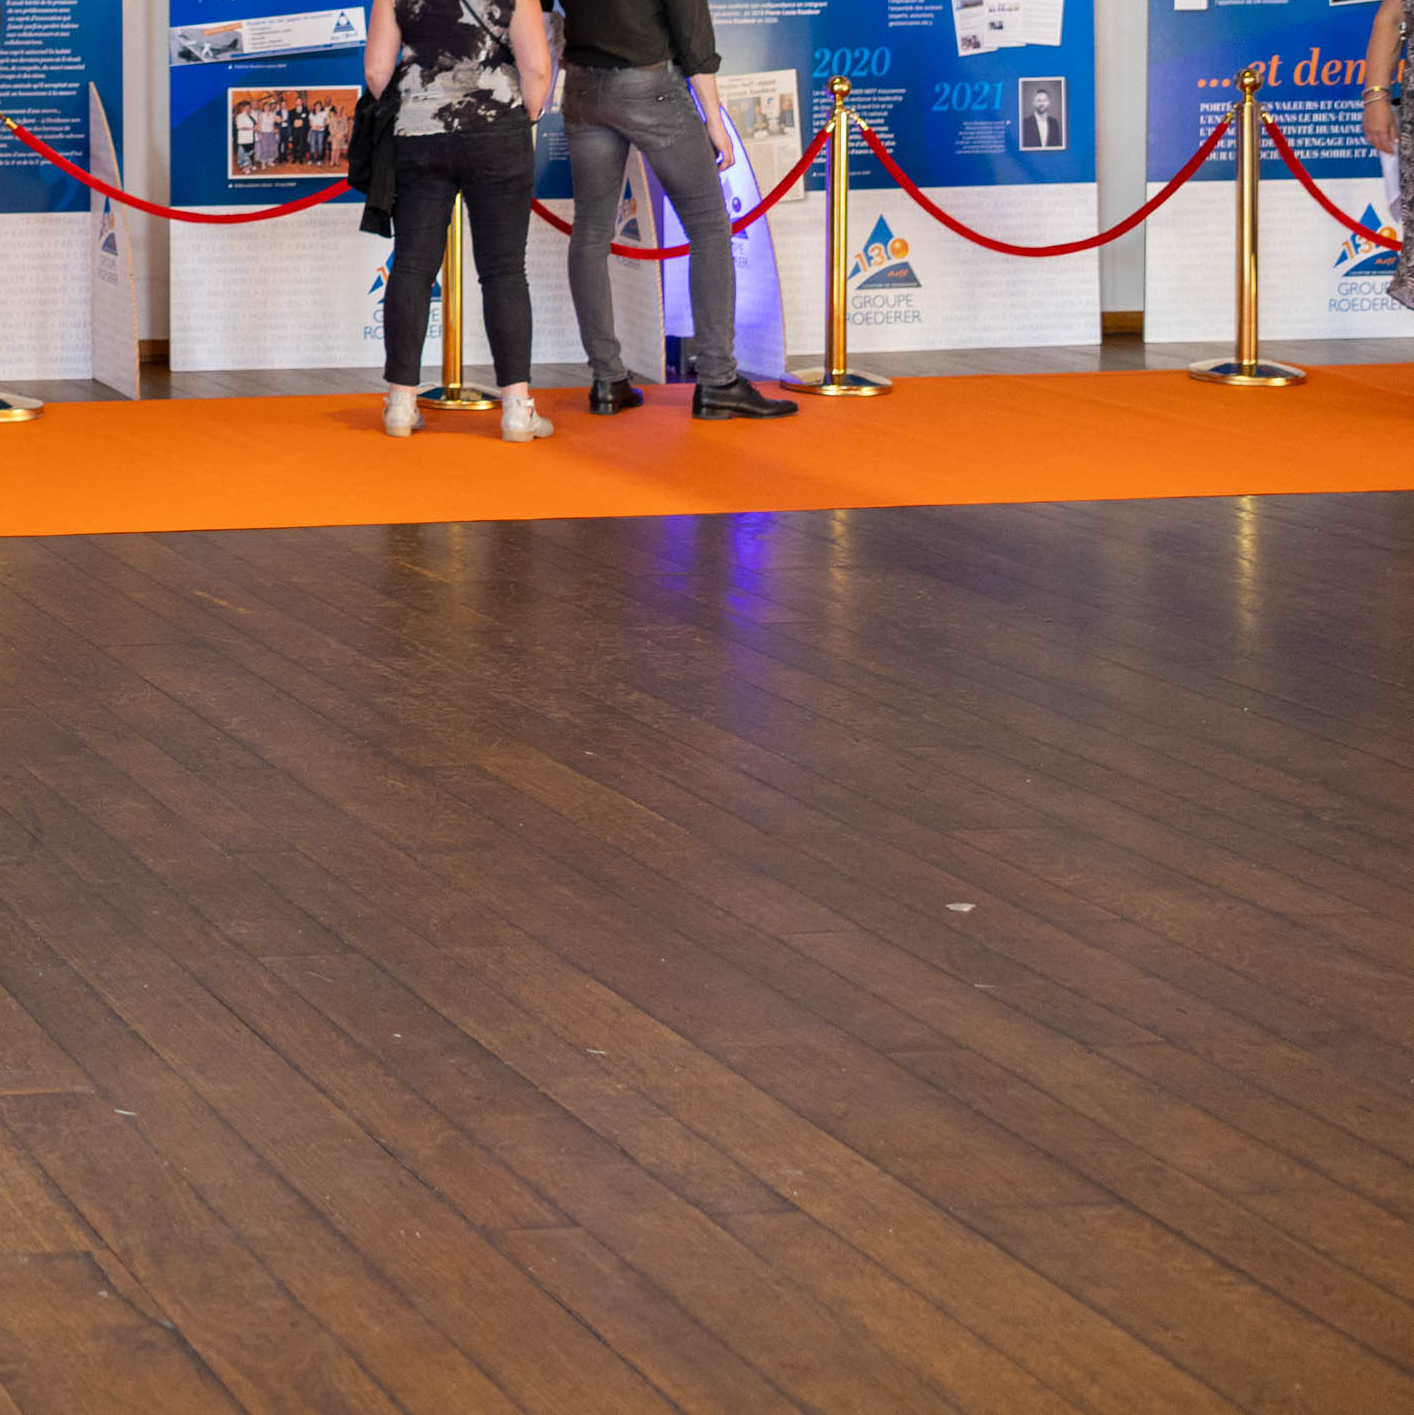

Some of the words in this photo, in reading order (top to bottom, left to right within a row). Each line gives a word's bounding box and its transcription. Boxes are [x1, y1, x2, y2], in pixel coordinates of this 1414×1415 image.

[812, 47, 892, 78] 2020
[932, 81, 1005, 112] 2021
[1200, 101, 1231, 111] PORTÉ
[1275, 101, 1319, 110] VALEURS
[1320, 101, 1332, 109] ET
[1273, 114, 1297, 123] DANS
[1299, 114, 1310, 122] LE
[1297, 137, 1343, 146] S'ENGAGE
[1295, 149, 1318, 158] PLUS
[1320, 149, 1352, 158] SOBRE
[1354, 149, 1366, 157] ET
[855, 238, 909, 273] 130
[852, 294, 914, 308] GROUPE
